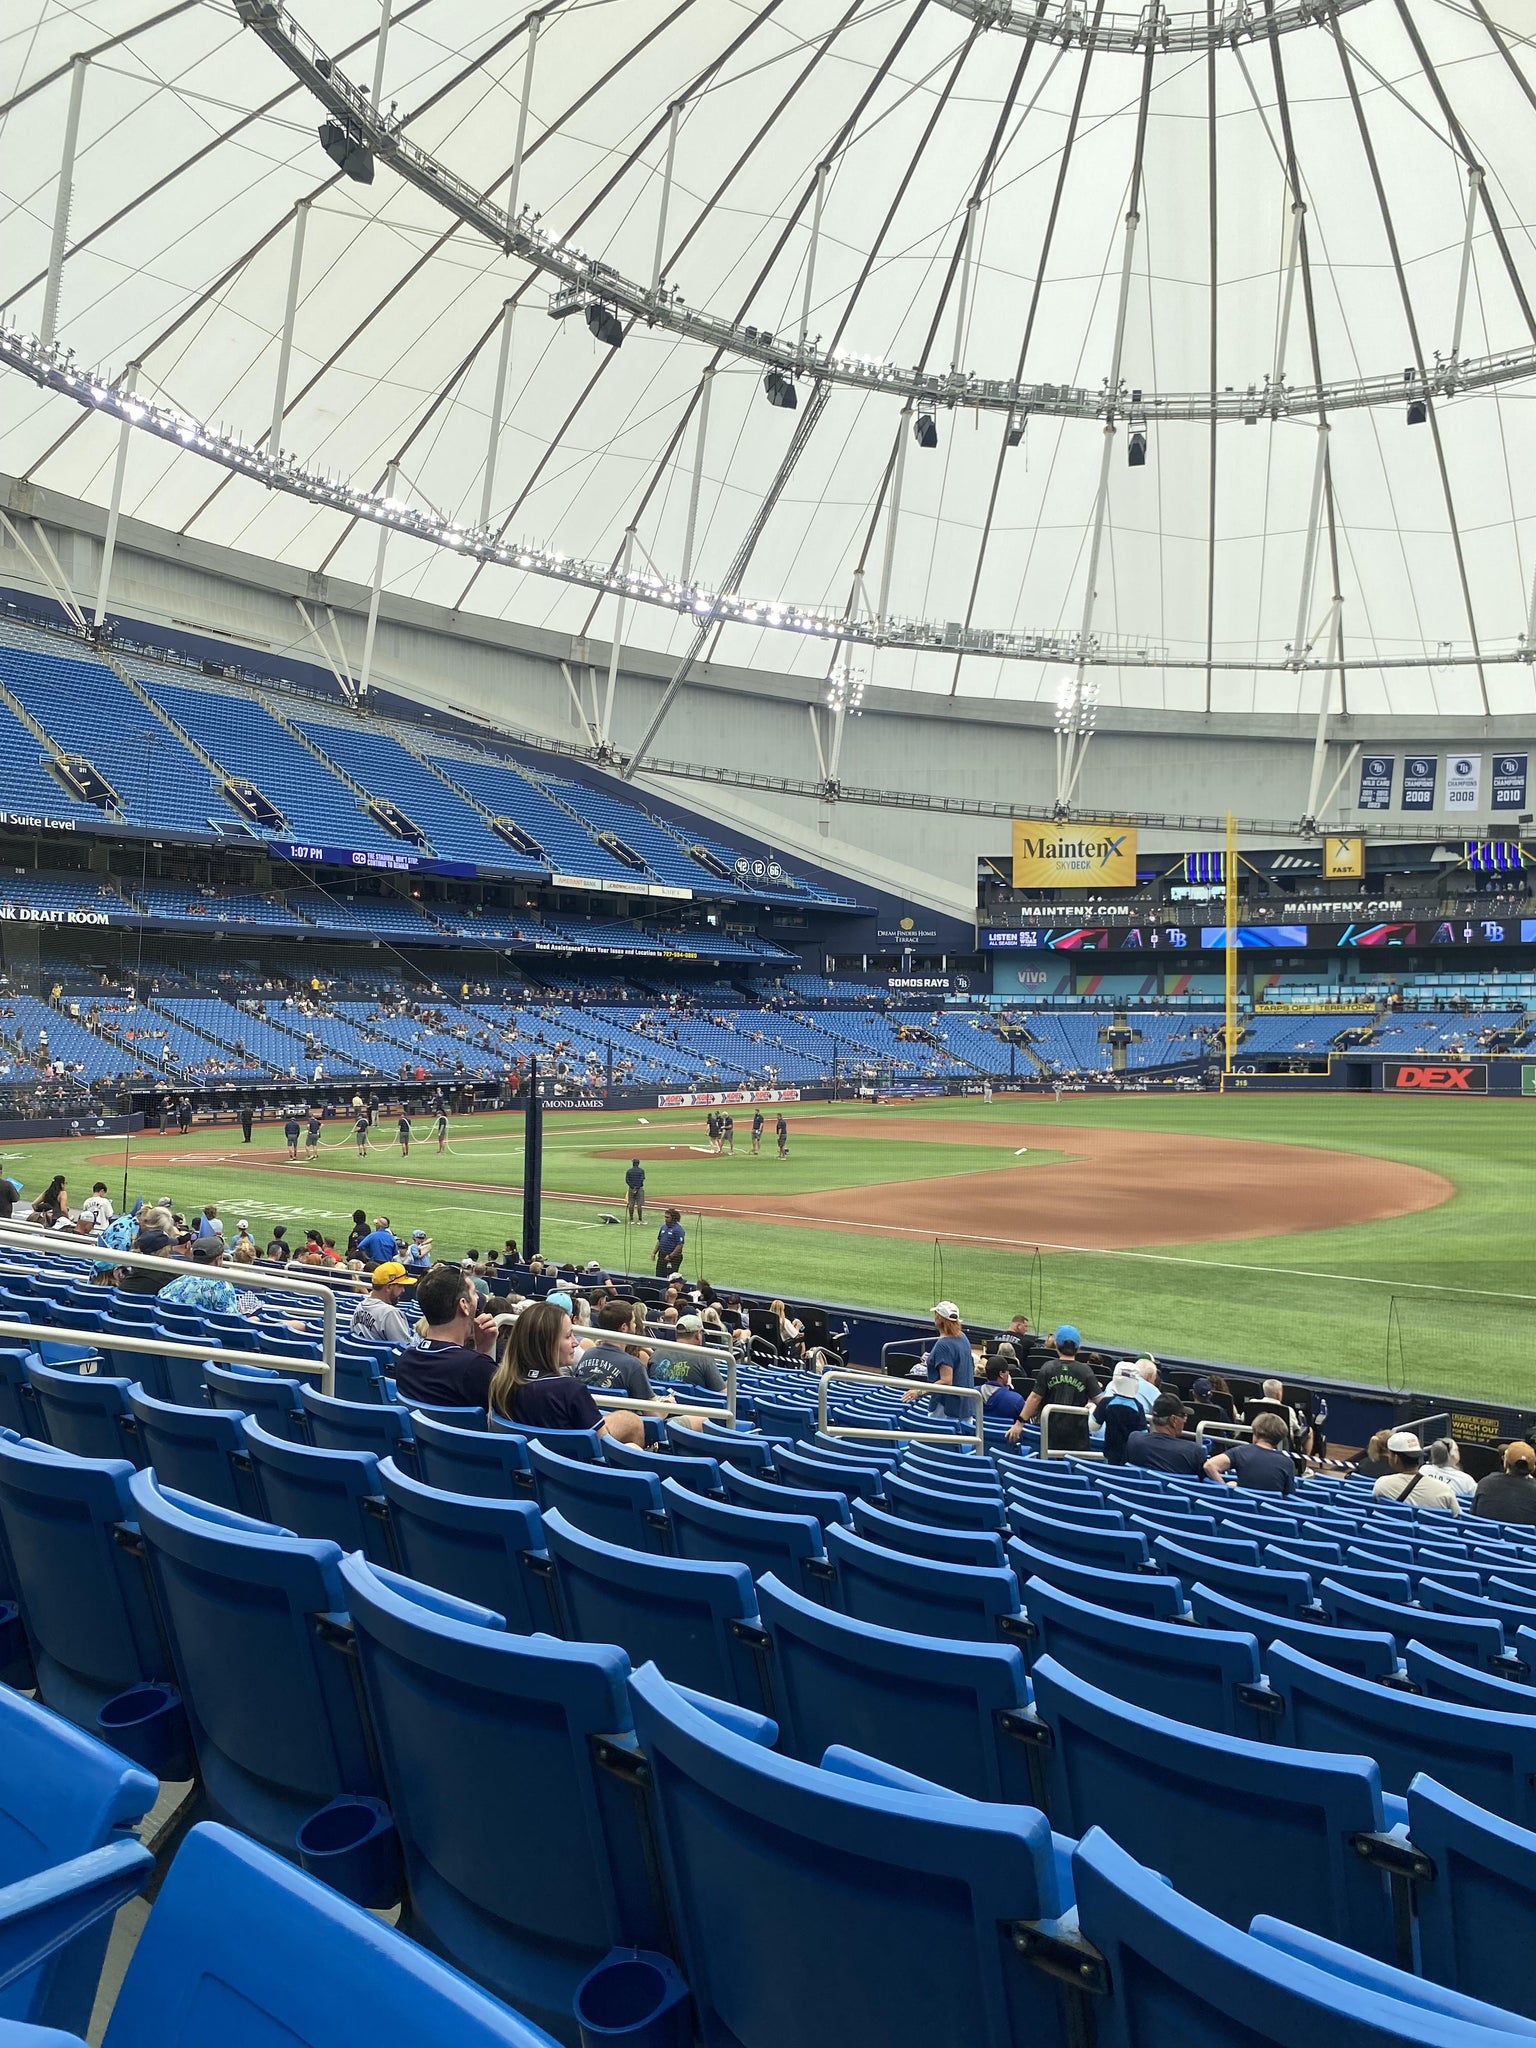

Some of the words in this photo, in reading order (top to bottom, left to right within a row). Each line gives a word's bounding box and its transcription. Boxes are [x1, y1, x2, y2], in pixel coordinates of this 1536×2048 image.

[1404, 780, 1434, 788] CHAMPIONS
[1447, 780, 1478, 788] CHAMPIONS
[1493, 779, 1525, 787] CHAMPIONS
[1405, 791, 1431, 802] 2008
[1449, 791, 1475, 802] 2008
[1496, 789, 1520, 802] 2010
[10, 814, 42, 828] Suite
[44, 817, 76, 831] Level
[290, 845, 309, 859] 1:07
[310, 847, 323, 860] PM
[1022, 836, 1127, 867] MaintenX
[737, 861, 748, 872] 42
[754, 863, 763, 874] 12
[769, 865, 779, 876] 66
[1056, 860, 1091, 871] SKYDECK
[1021, 905, 1129, 916] MAINTENX.COM
[1284, 900, 1403, 914] MAINTENX.COM
[19, 908, 64, 923] DRAFT
[67, 911, 110, 926] ROOM
[988, 933, 1018, 941] LISTEN
[535, 942, 550, 951] Need
[550, 943, 584, 953] Assistance?
[585, 945, 597, 953] Text
[599, 946, 610, 954] Your
[635, 949, 656, 957] Location
[1017, 971, 1047, 983] VIVA
[924, 978, 950, 988] RAYS
[1395, 1066, 1474, 1090] DEX
[574, 1100, 604, 1108] JAMES
[85, 1362, 92, 1374] V
[600, 1359, 613, 1371] DAY
[1452, 1421, 1480, 1431] WATCH
[1481, 1425, 1499, 1434] OUT
